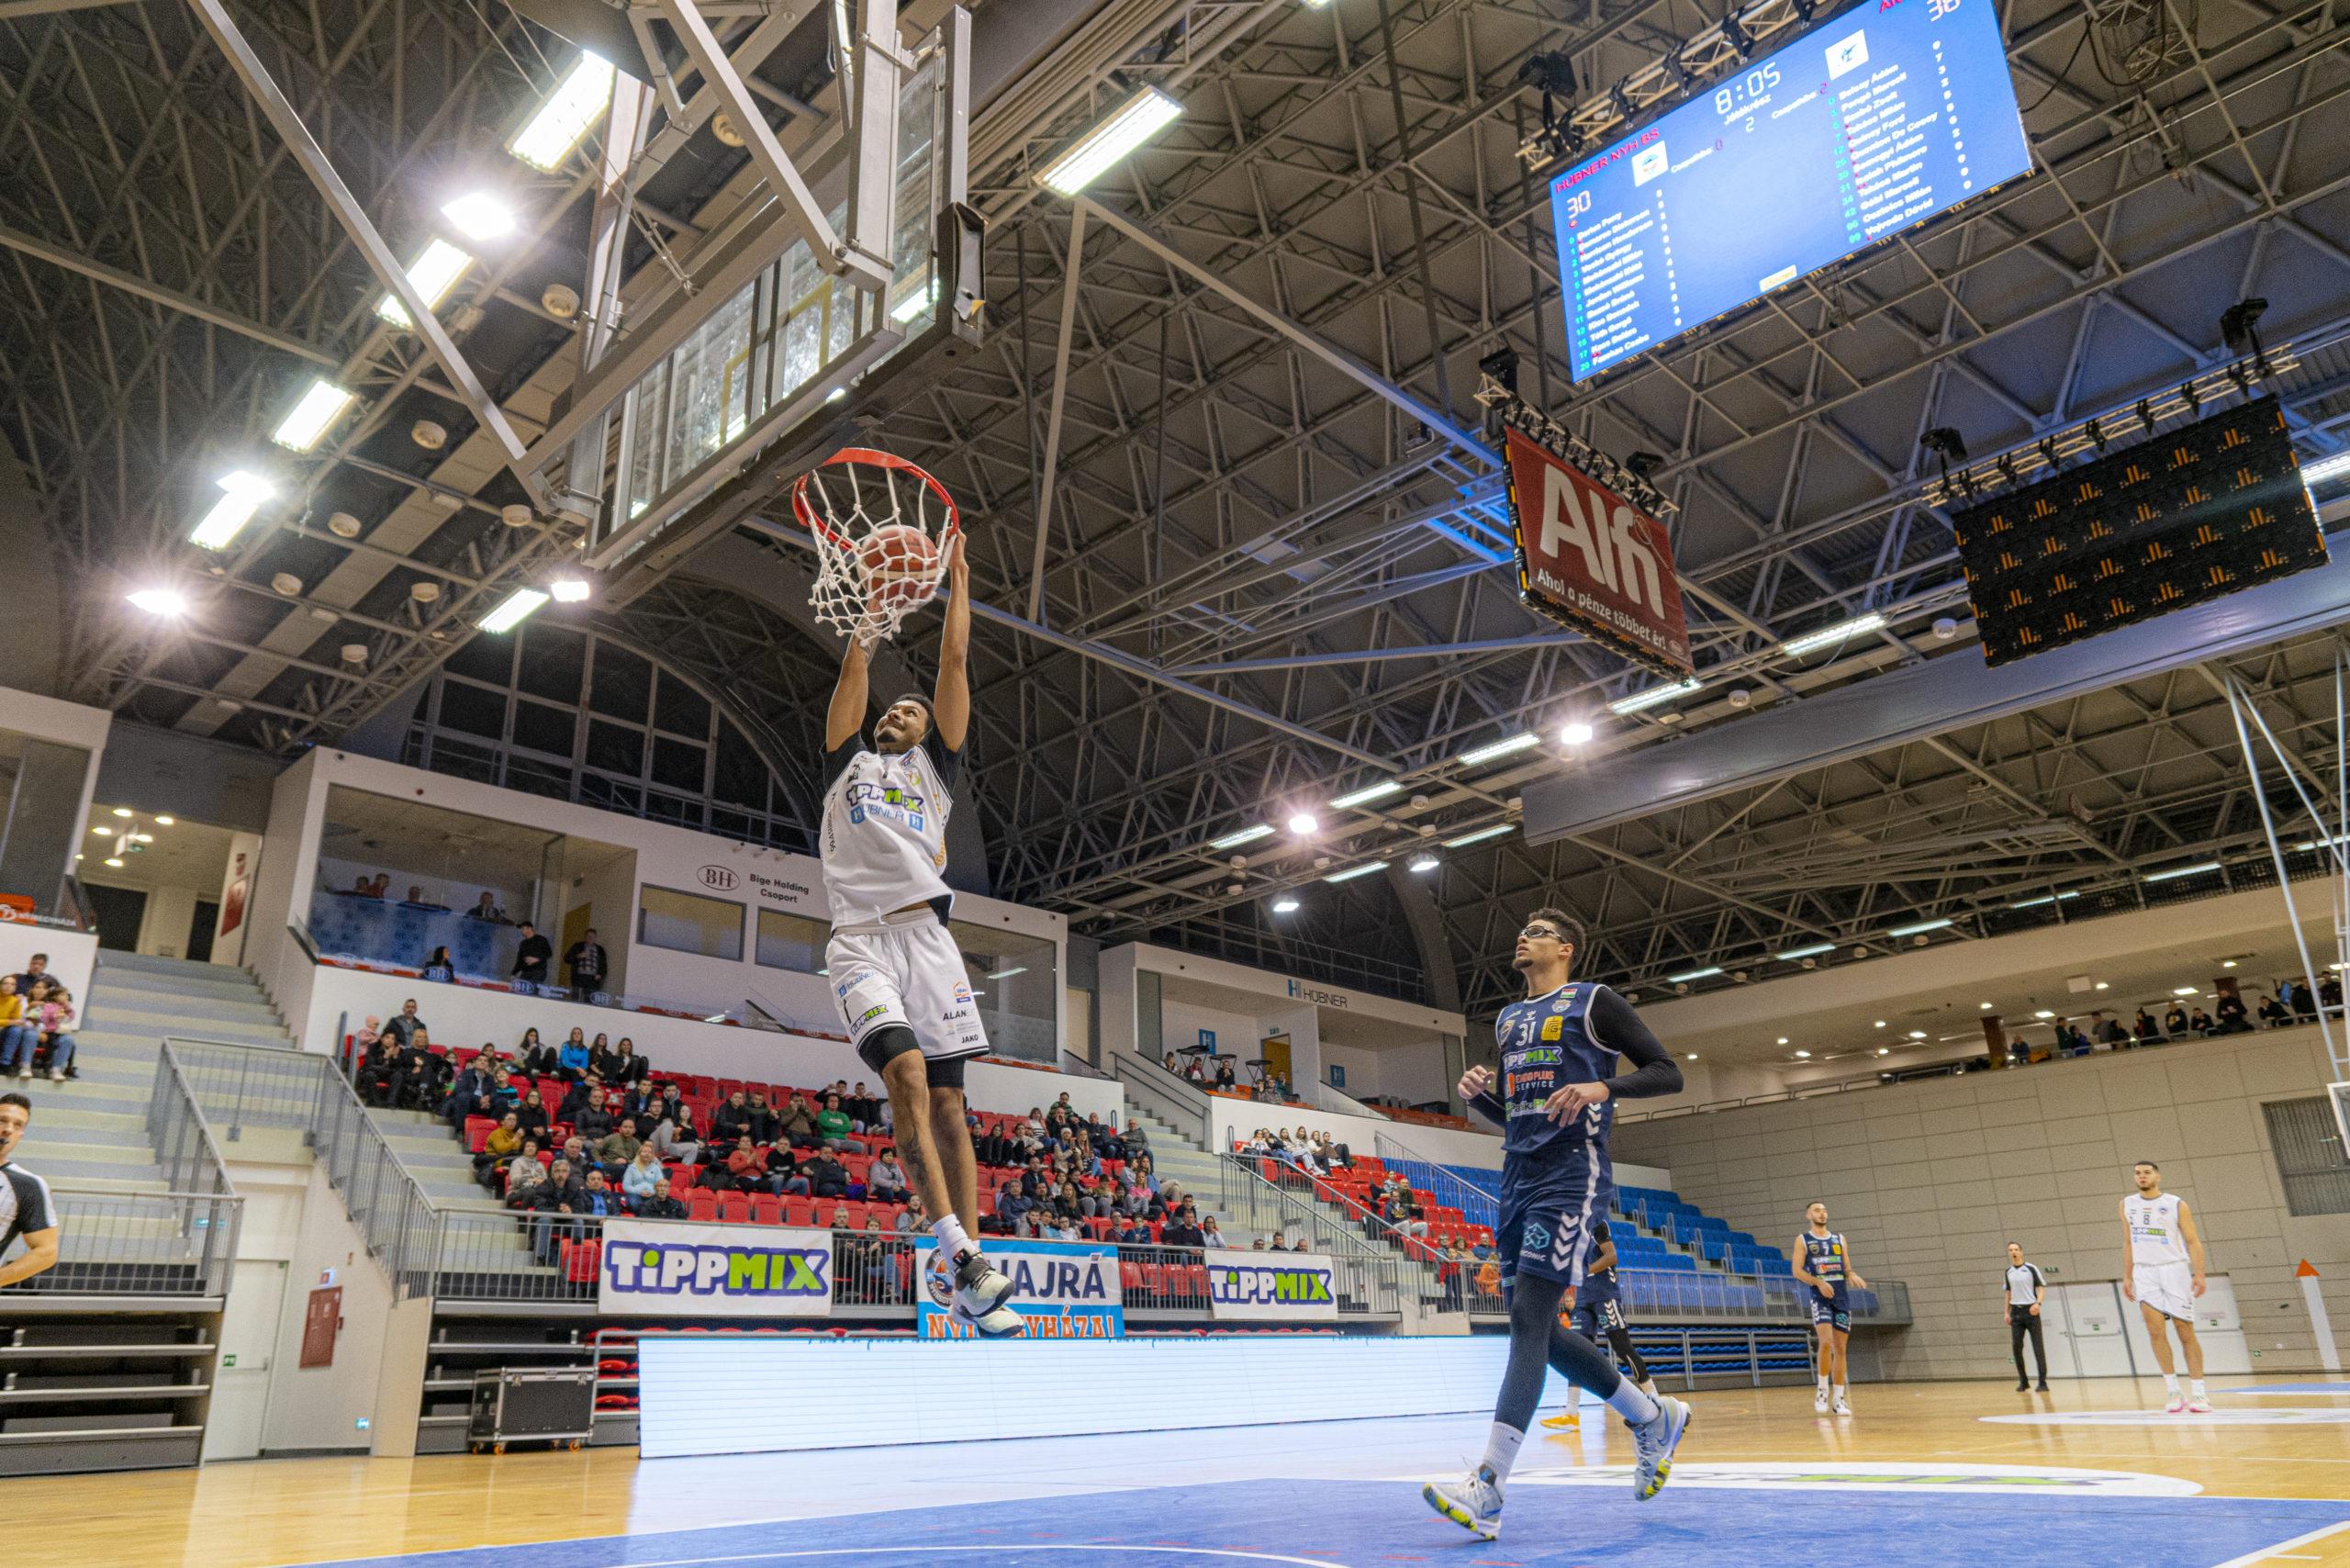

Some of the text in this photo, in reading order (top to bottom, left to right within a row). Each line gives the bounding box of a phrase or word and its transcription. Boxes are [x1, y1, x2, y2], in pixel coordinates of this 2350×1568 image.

[1936, 53, 1942, 62] 7
[1939, 66, 1945, 74] 3
[1715, 62, 1781, 115] 8:05
[1942, 78, 1949, 87] 2
[1745, 116, 1754, 132] 2
[1953, 129, 1960, 137] 2
[1610, 139, 1638, 162] NYH
[1640, 128, 1660, 145] BS
[1567, 190, 1591, 218] 30
[1846, 207, 1856, 217] 42
[1538, 568, 1564, 595] Ahol
[1568, 587, 1575, 600] a
[1578, 592, 1612, 620] pénze
[1614, 610, 1651, 641] többet
[1651, 631, 1667, 650] ér!
[705, 868, 733, 888] BH
[749, 874, 809, 895] Bige Holding
[760, 889, 798, 902] Csoport
[961, 1034, 979, 1044] JAKO
[1516, 1021, 1537, 1047] 31
[1516, 1081, 1555, 1092] SERVICE
[1822, 1245, 1830, 1256] 7
